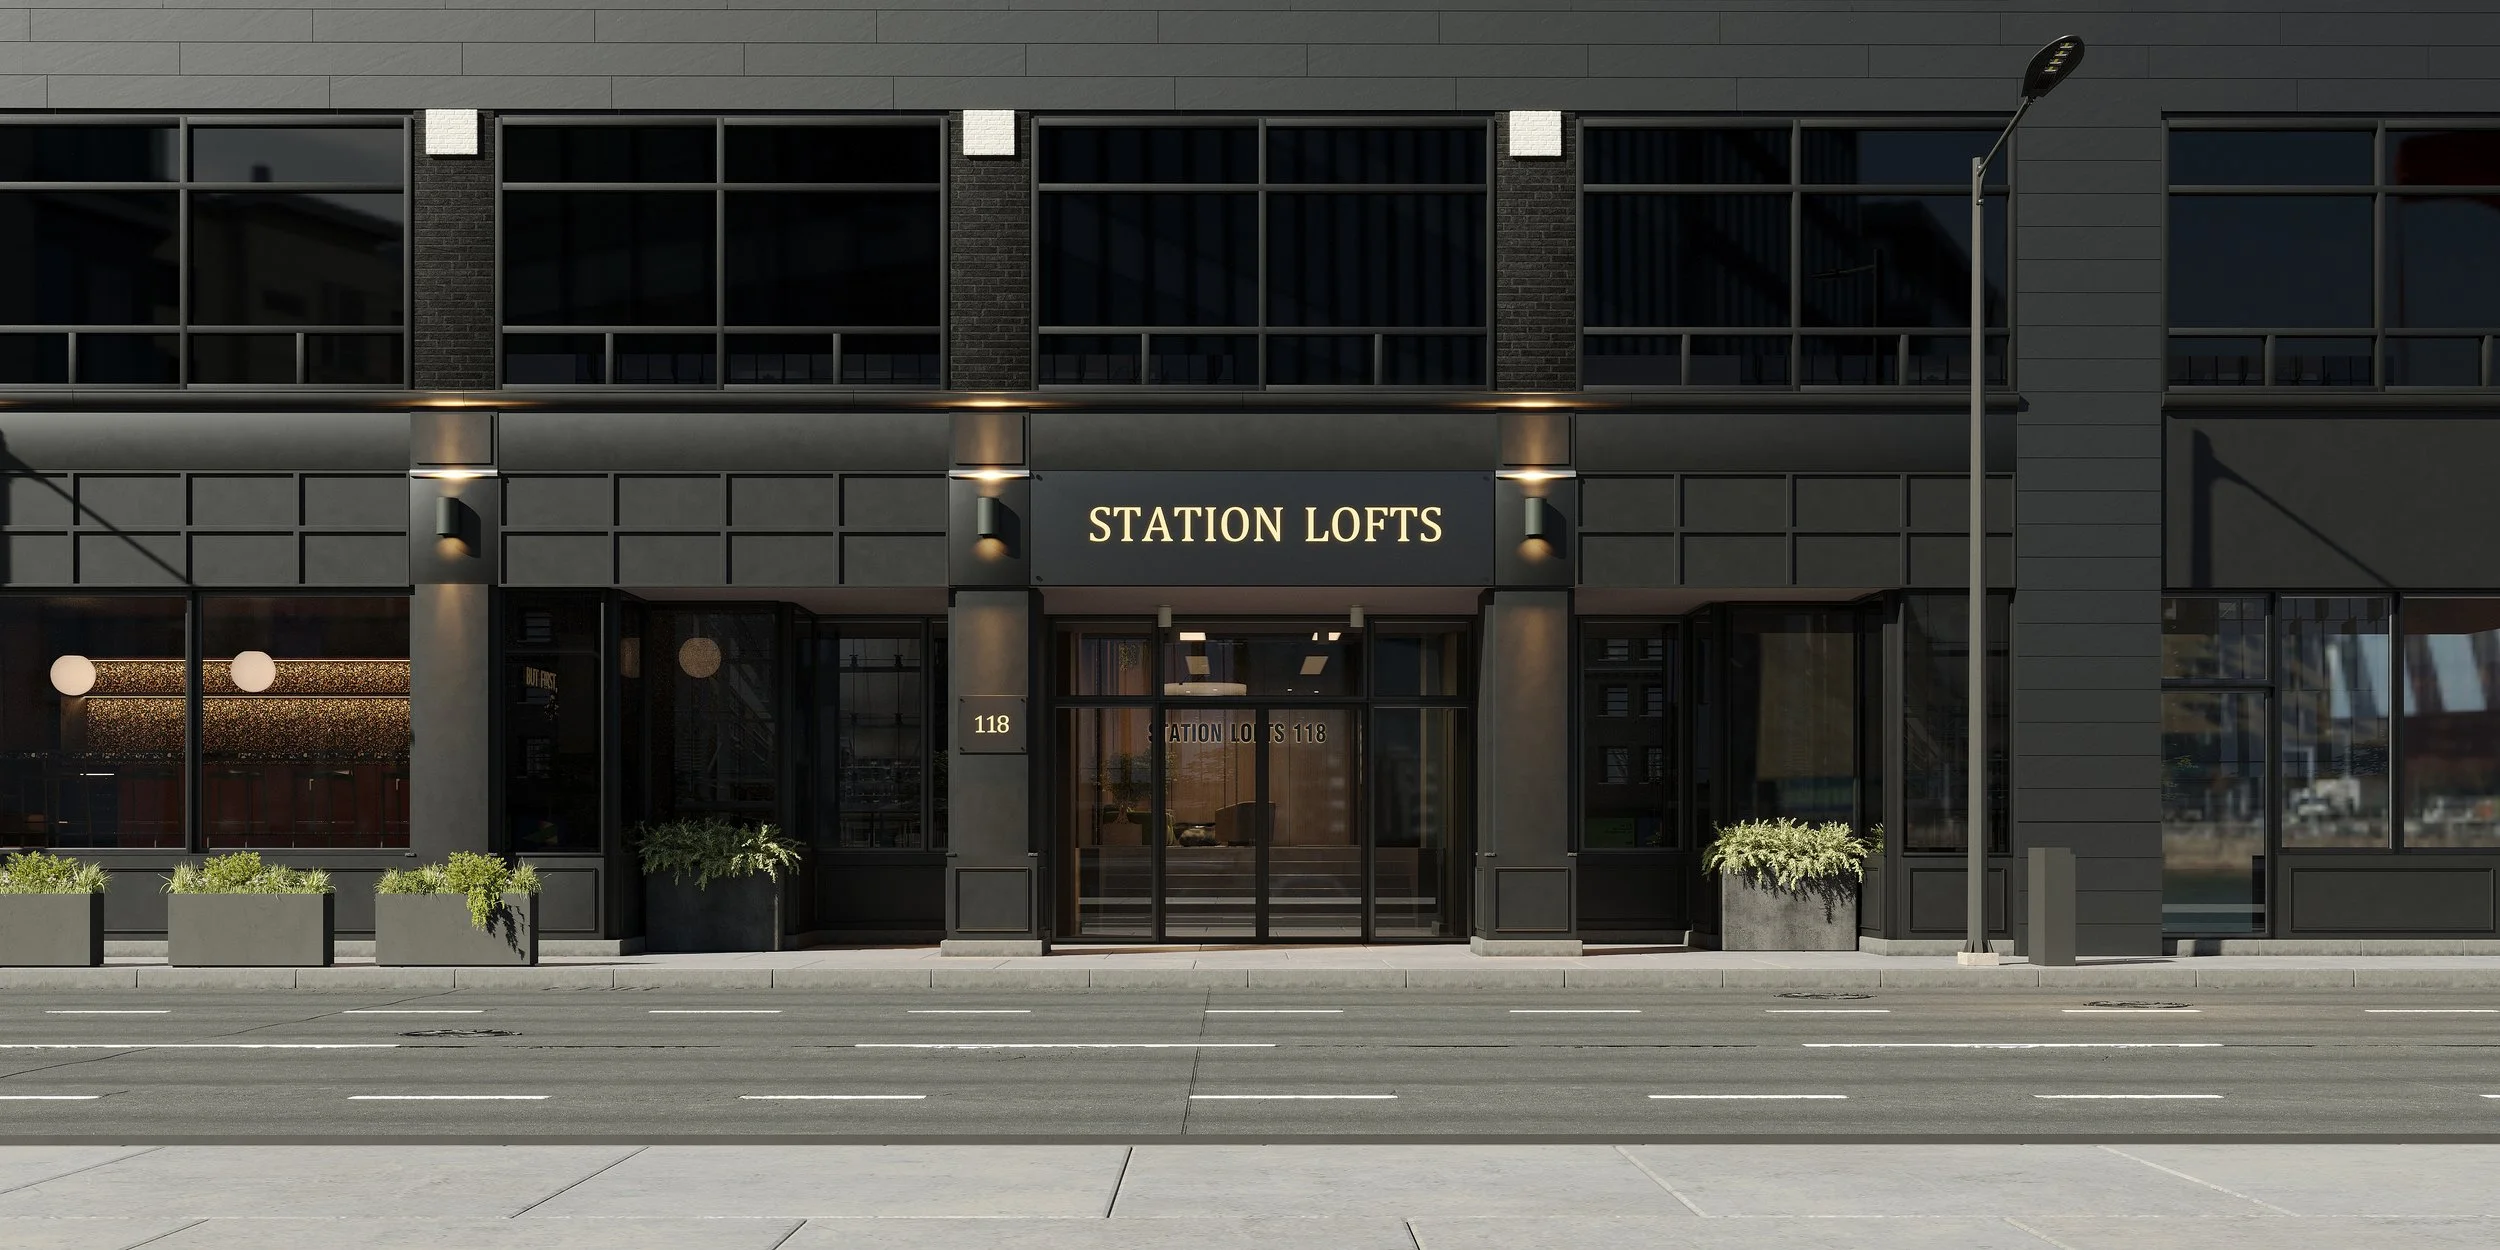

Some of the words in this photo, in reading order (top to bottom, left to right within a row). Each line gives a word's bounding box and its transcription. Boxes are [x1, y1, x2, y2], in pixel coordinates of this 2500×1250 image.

[1089, 506, 1284, 543] STATION
[1304, 506, 1442, 543] LOFTS
[525, 666, 540, 687] BUT
[974, 714, 1010, 734] 118
[1293, 722, 1327, 743] 118
